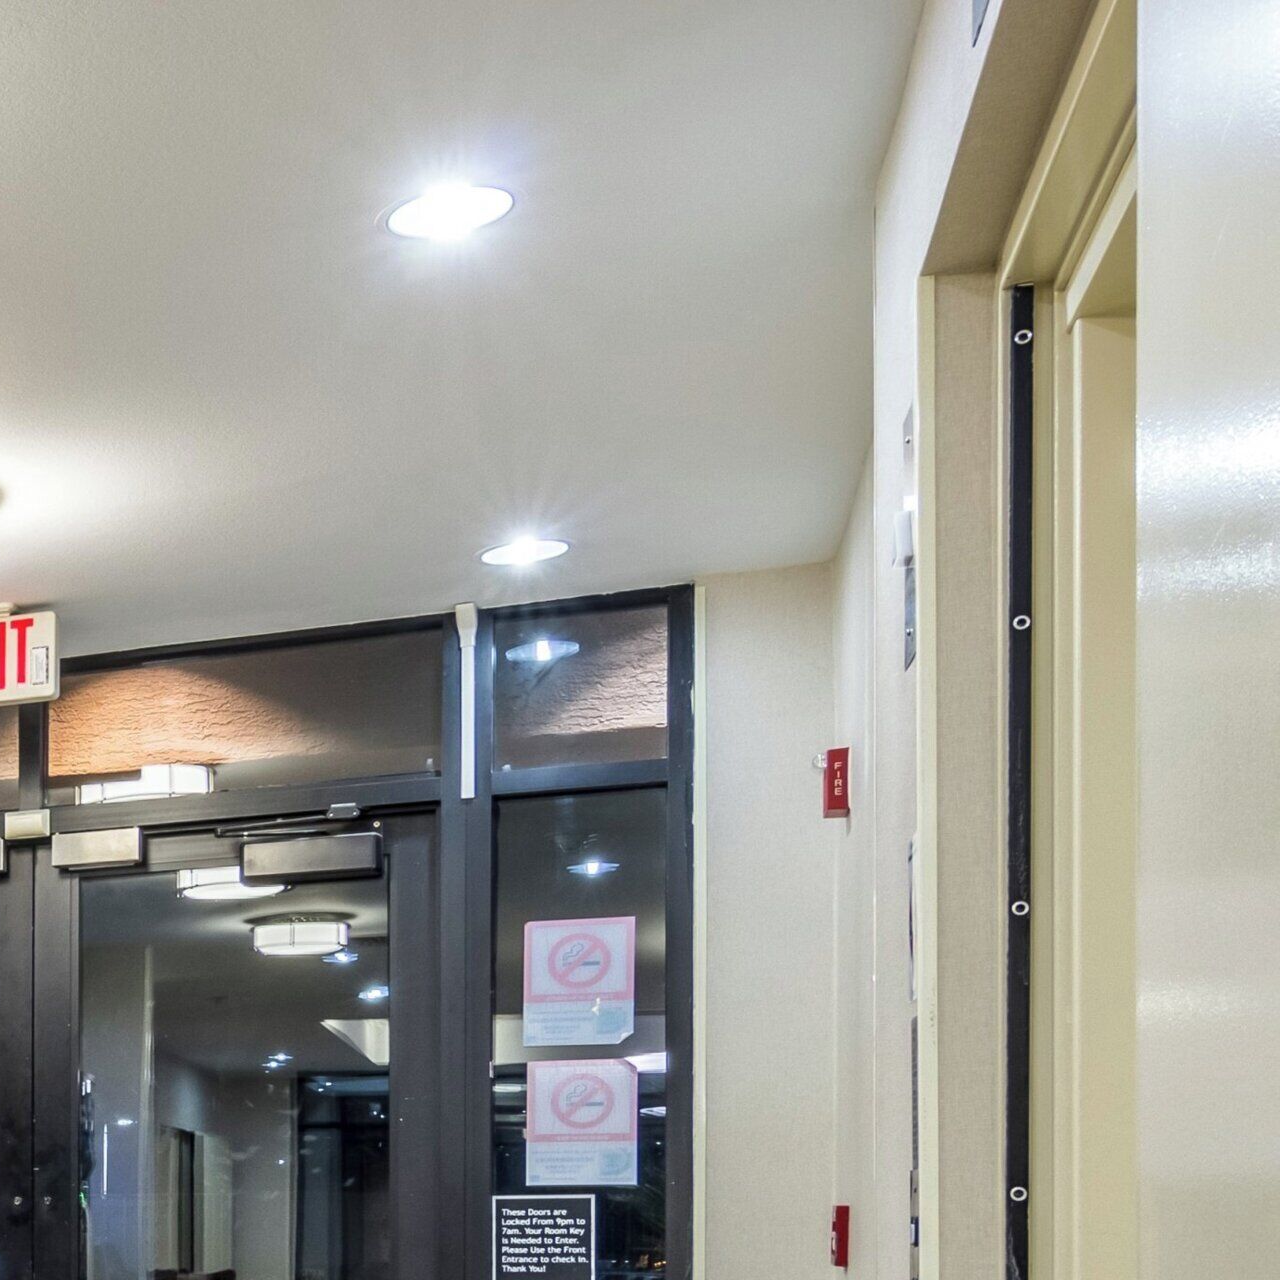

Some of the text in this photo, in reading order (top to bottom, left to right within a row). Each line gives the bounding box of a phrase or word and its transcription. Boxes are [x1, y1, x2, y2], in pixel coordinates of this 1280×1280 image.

[834, 761, 843, 795] FIRE
[502, 1208, 525, 1216] These
[528, 1208, 551, 1216] Doors
[556, 1218, 574, 1226] 9pm
[545, 1227, 567, 1235] Room
[570, 1227, 585, 1236] Key
